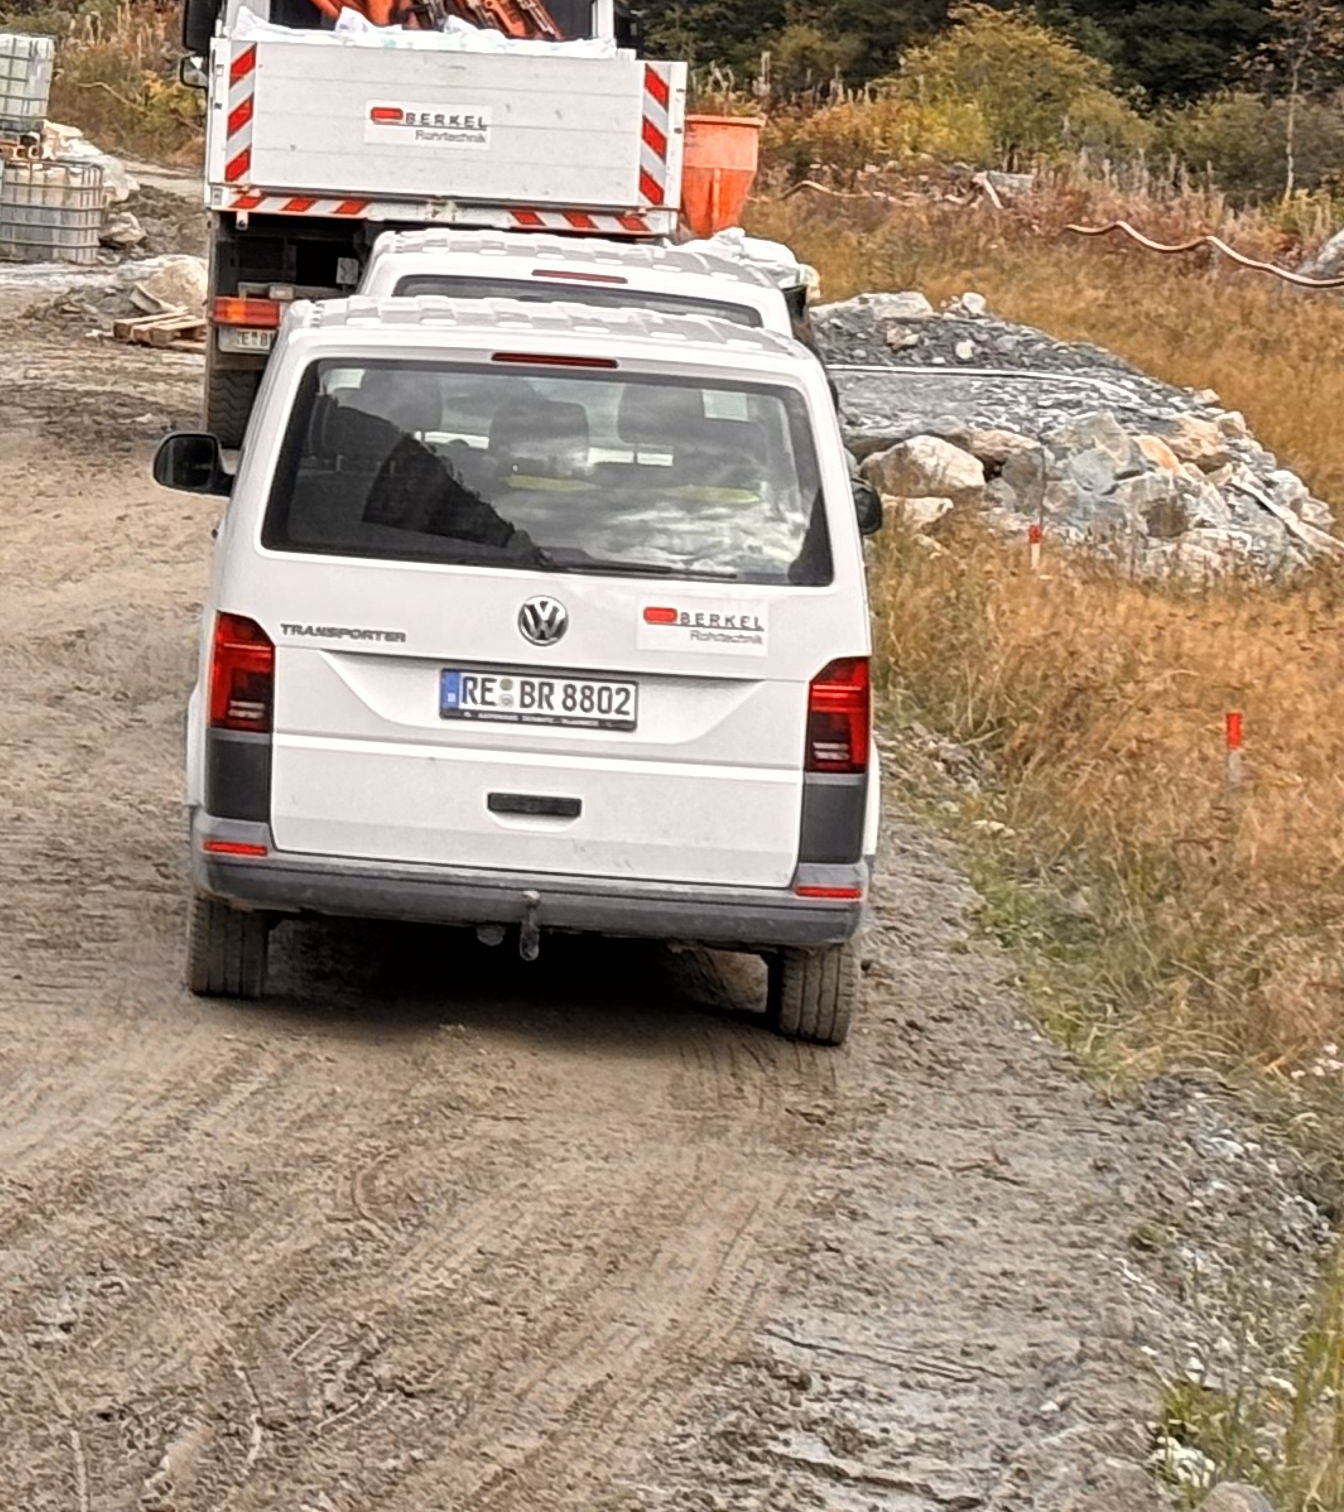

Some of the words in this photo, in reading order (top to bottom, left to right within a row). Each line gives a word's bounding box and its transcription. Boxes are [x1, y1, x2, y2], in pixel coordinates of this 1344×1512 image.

[405, 112, 487, 130] BERKEL
[680, 611, 764, 632] BERKEL
[279, 623, 407, 643] TRANSPORTER
[462, 676, 497, 706] RE
[519, 680, 555, 711] BR
[561, 683, 631, 716] 8802
